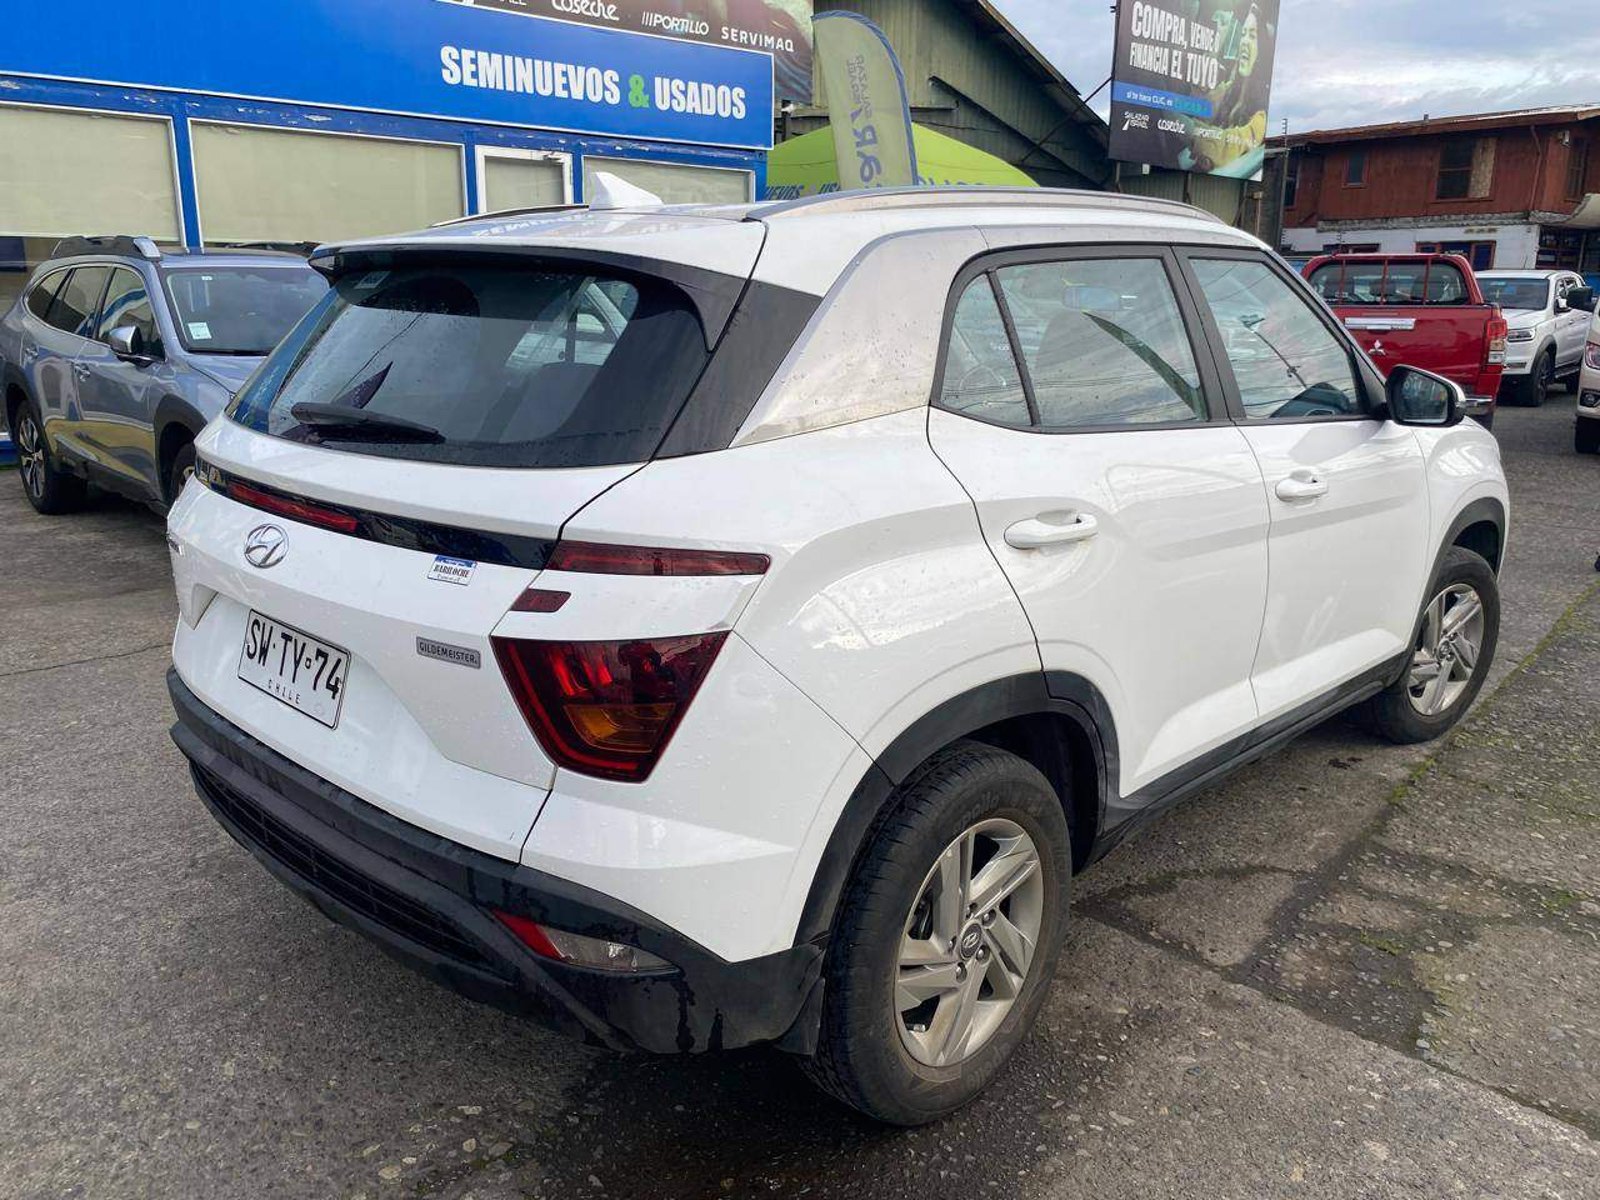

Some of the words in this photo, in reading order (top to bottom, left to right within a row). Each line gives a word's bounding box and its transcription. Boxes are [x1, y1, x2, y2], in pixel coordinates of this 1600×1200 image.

[721, 26, 795, 53] SERVIMAQ
[1131, 1, 1187, 50] COMPRA,
[441, 45, 620, 105] SEMINUEVOS
[628, 74, 650, 108] &
[654, 76, 747, 120] USADOS
[1129, 42, 1170, 76] FINANCIA
[1170, 49, 1183, 80] EL
[1186, 52, 1218, 90] TUYO
[267, 678, 301, 705] CHILE
